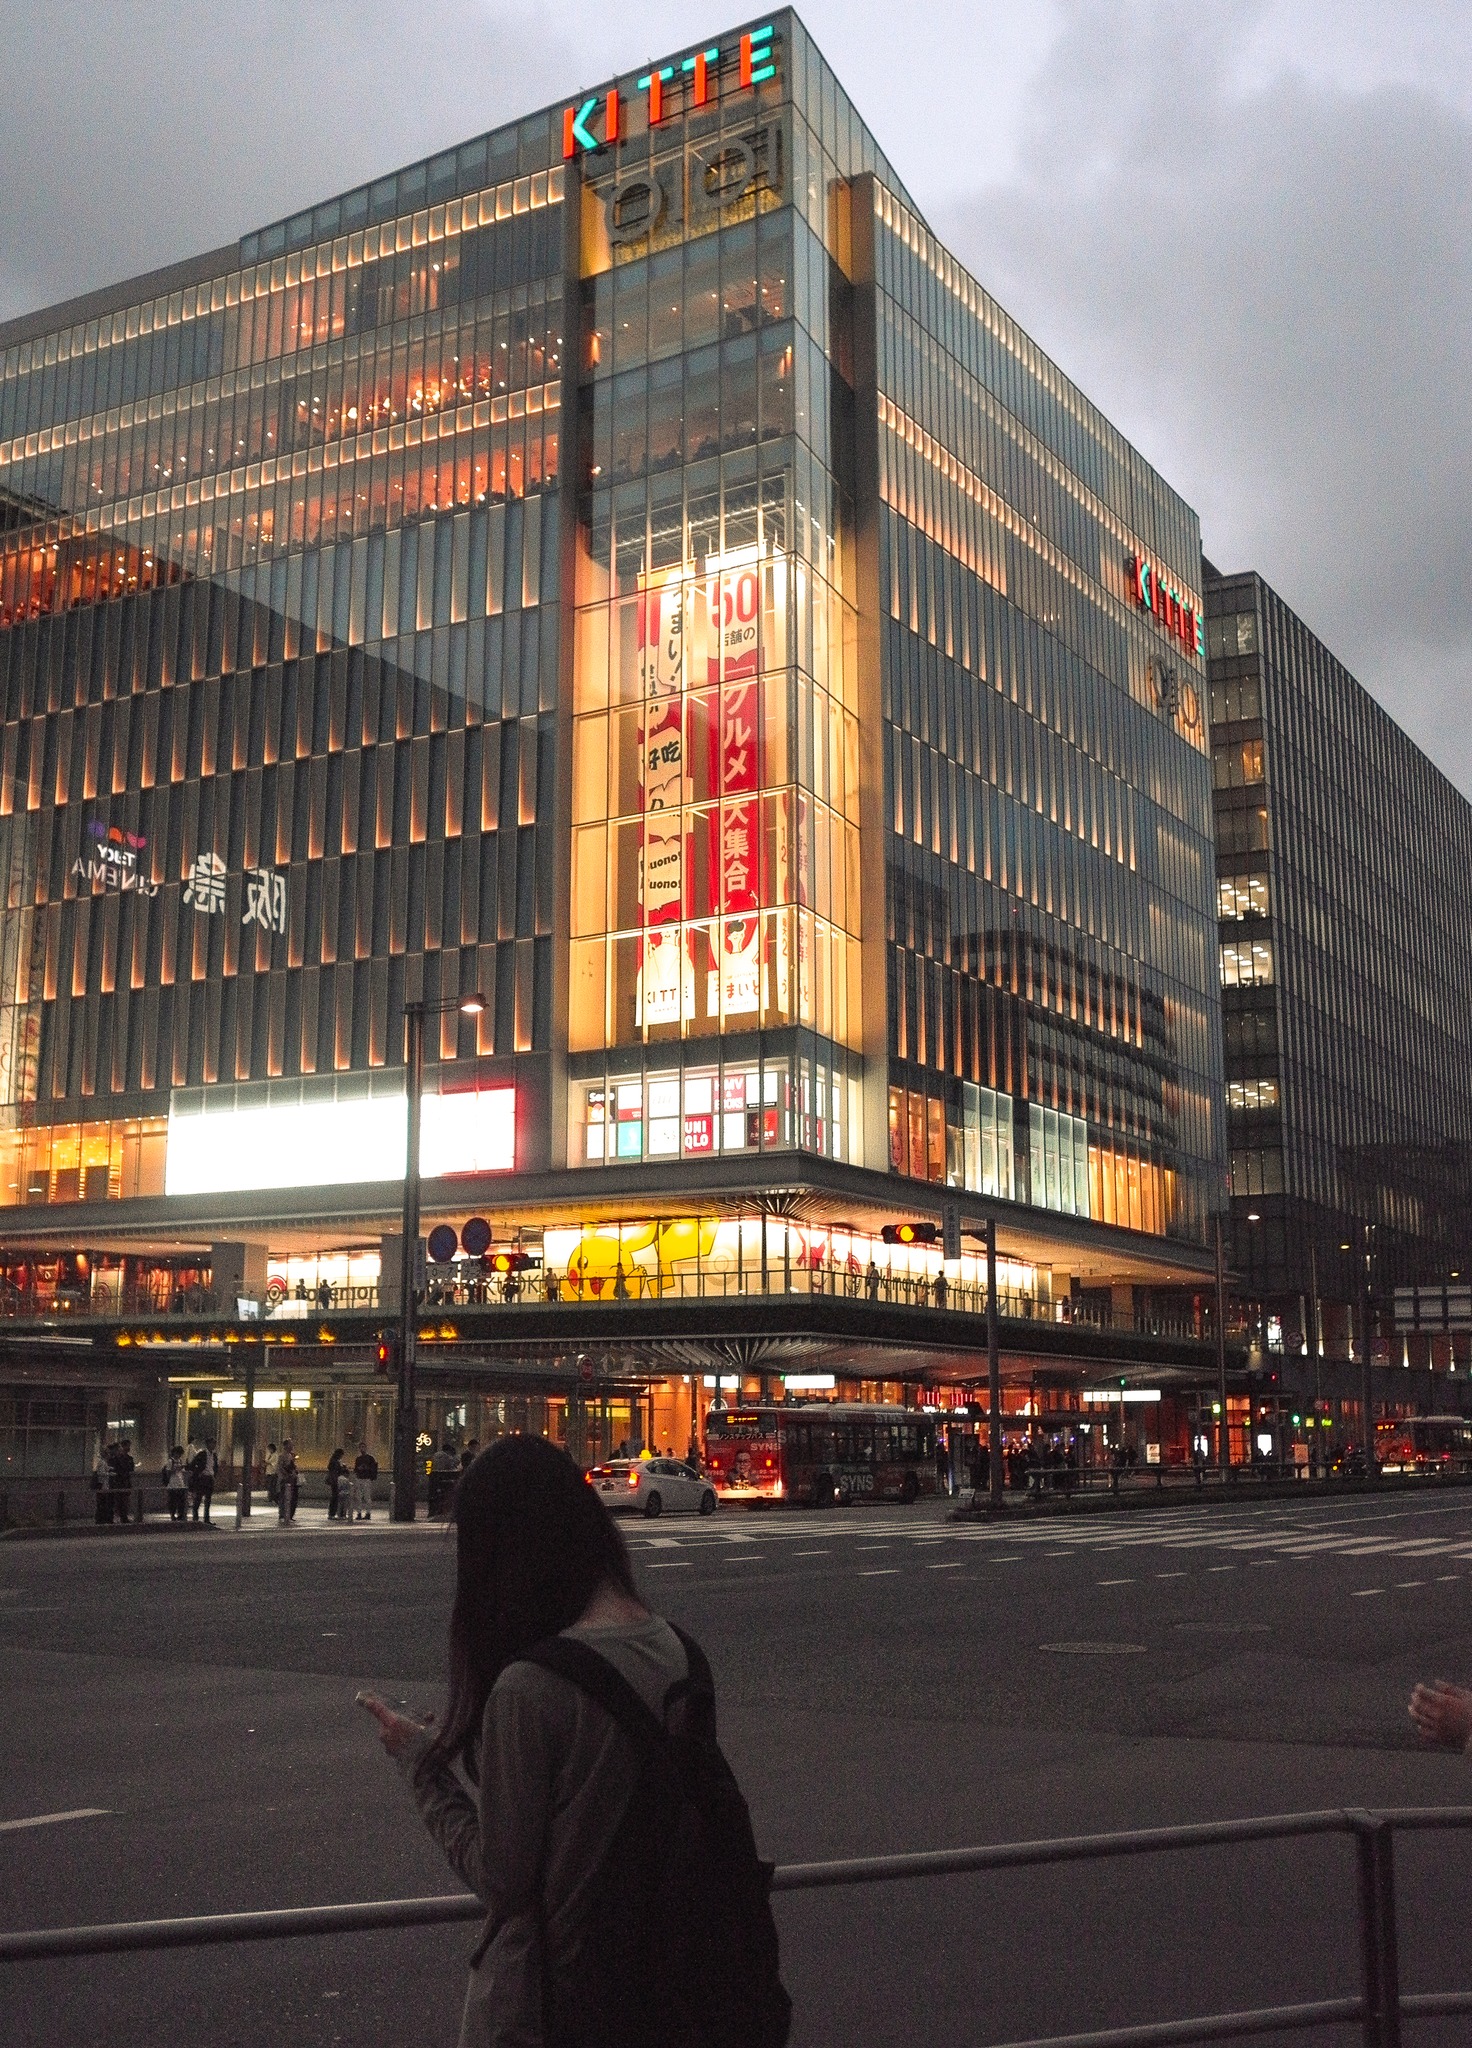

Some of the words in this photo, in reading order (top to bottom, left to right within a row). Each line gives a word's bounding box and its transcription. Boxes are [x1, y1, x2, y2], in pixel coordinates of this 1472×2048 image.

[563, 25, 776, 160] KITTE
[1134, 556, 1204, 656] KITTE
[685, 1120, 707, 1134] UNI
[685, 1133, 709, 1150] QLO
[839, 1474, 874, 1492] SYNS
